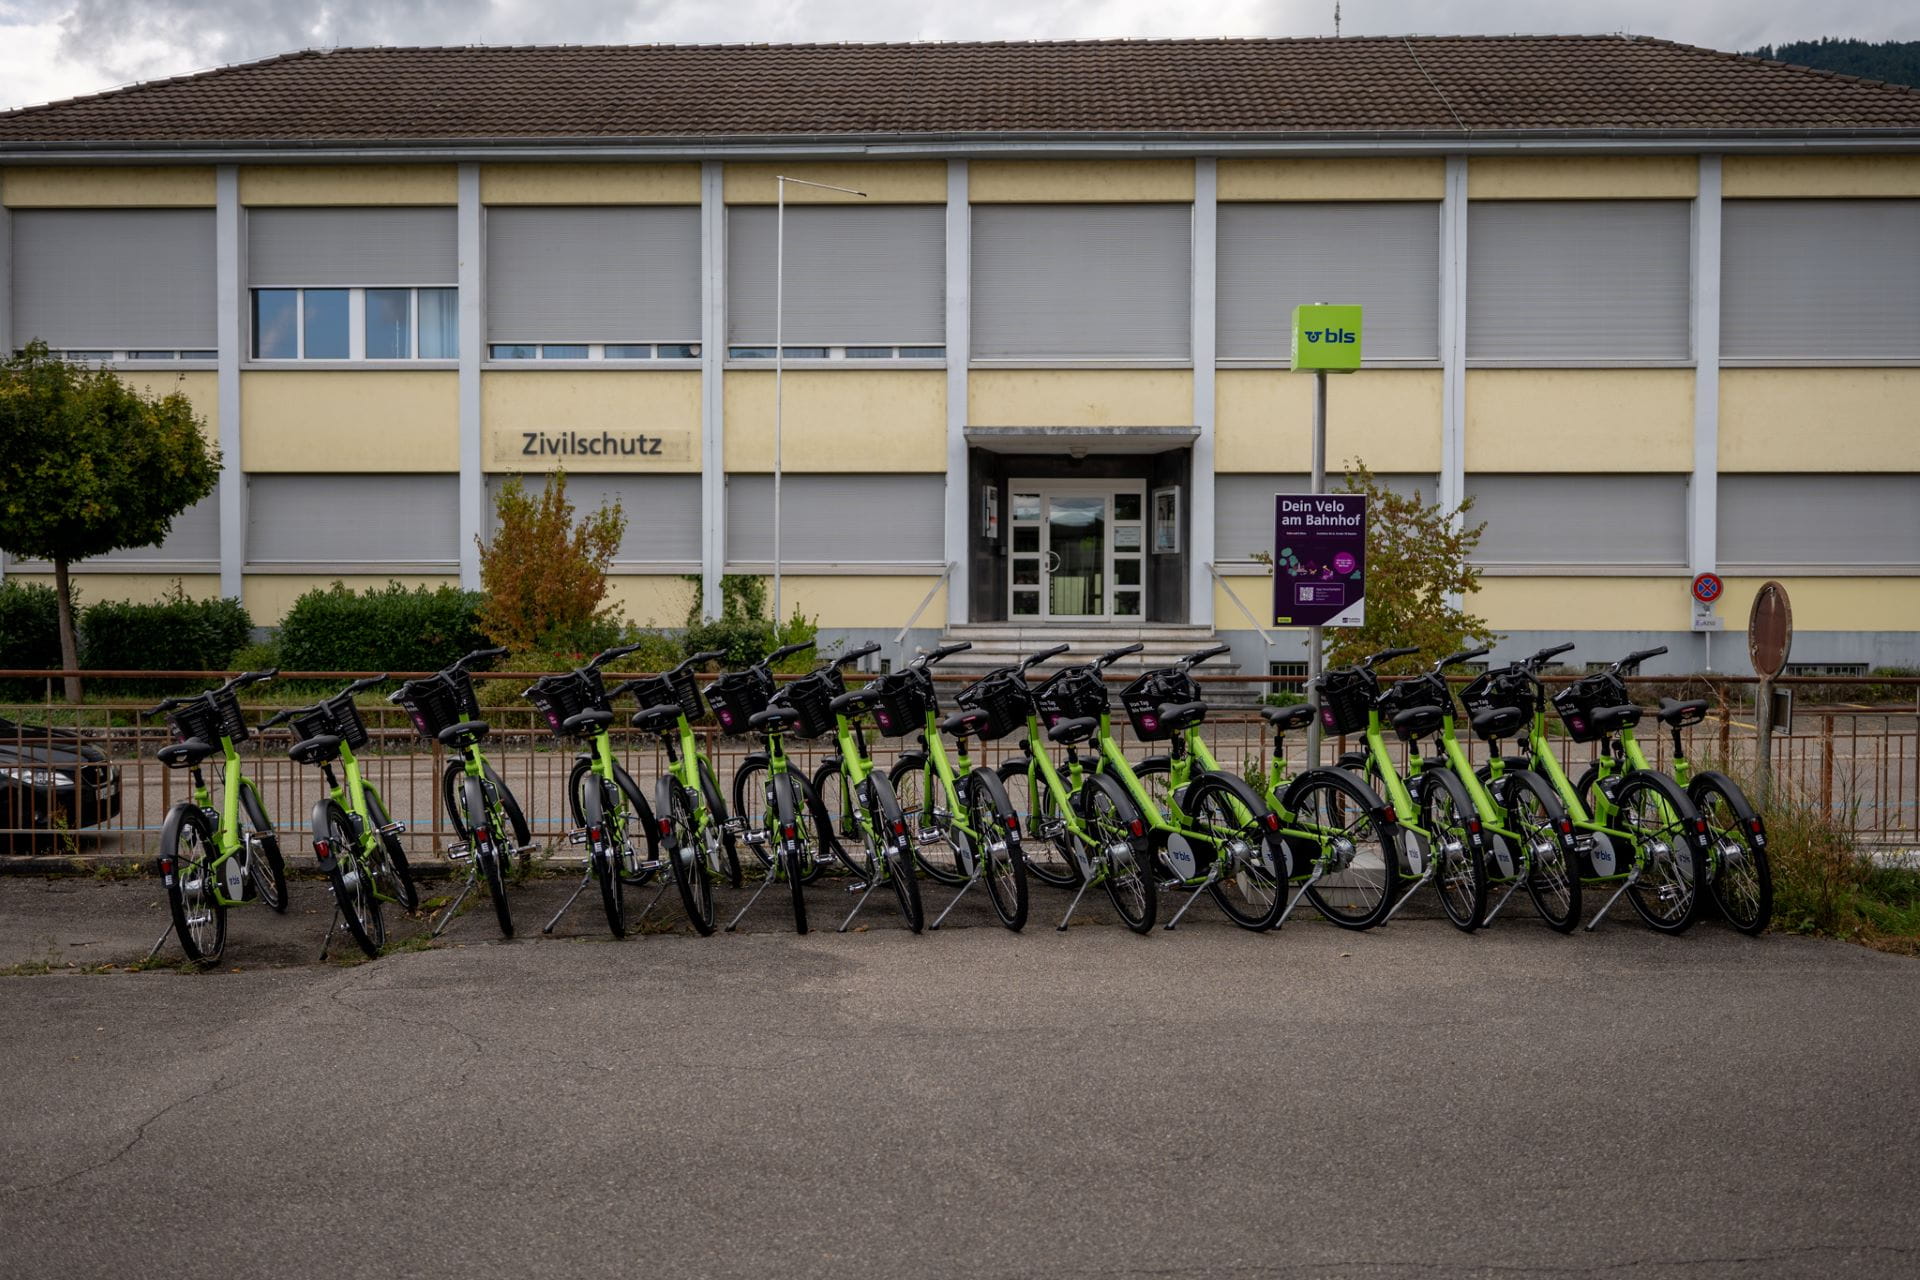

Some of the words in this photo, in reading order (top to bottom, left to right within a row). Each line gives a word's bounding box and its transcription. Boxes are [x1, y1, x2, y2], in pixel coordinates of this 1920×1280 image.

[1325, 328, 1355, 343] bls
[522, 431, 662, 456] Zivilschutz
[1282, 500, 1311, 512] Dein
[1315, 500, 1345, 512] Velo
[1281, 516, 1302, 526] am
[1306, 513, 1360, 526] Bahnhof
[1180, 851, 1190, 861] bls
[1601, 850, 1611, 861] bls
